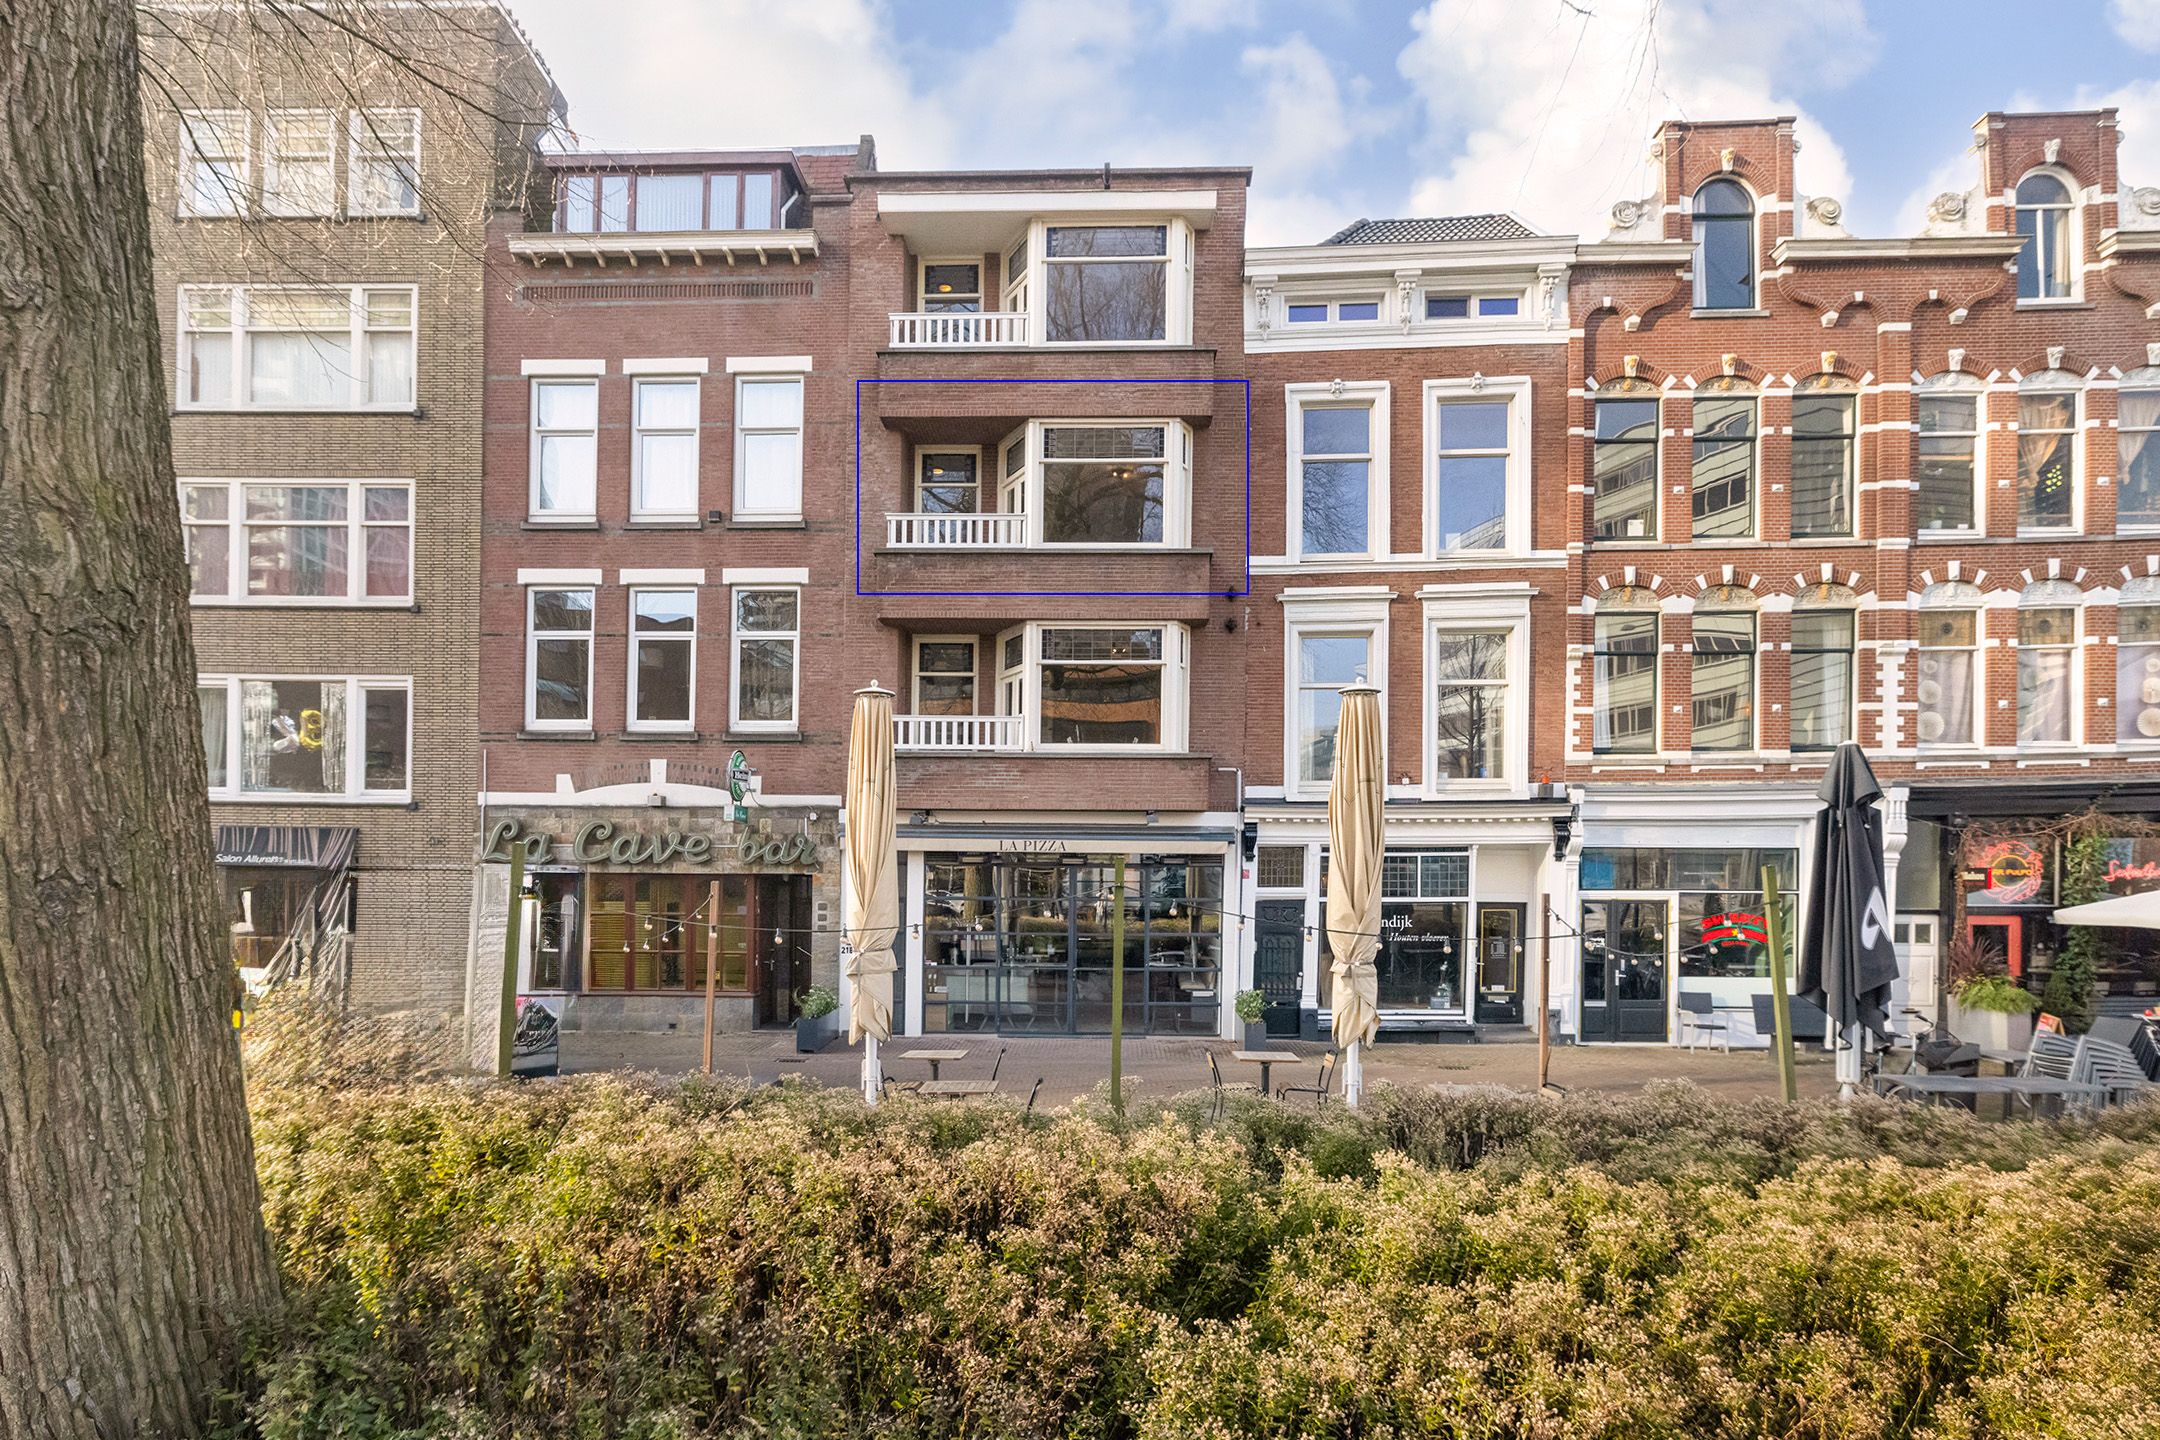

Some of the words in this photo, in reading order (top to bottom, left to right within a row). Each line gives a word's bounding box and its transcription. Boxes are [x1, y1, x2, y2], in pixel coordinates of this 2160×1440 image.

[482, 818, 553, 864] La
[573, 817, 711, 864] Cave
[737, 825, 817, 865] bar
[1000, 840, 1017, 851] LA
[1023, 840, 1066, 851] PIZZA
[214, 854, 242, 863] Salon
